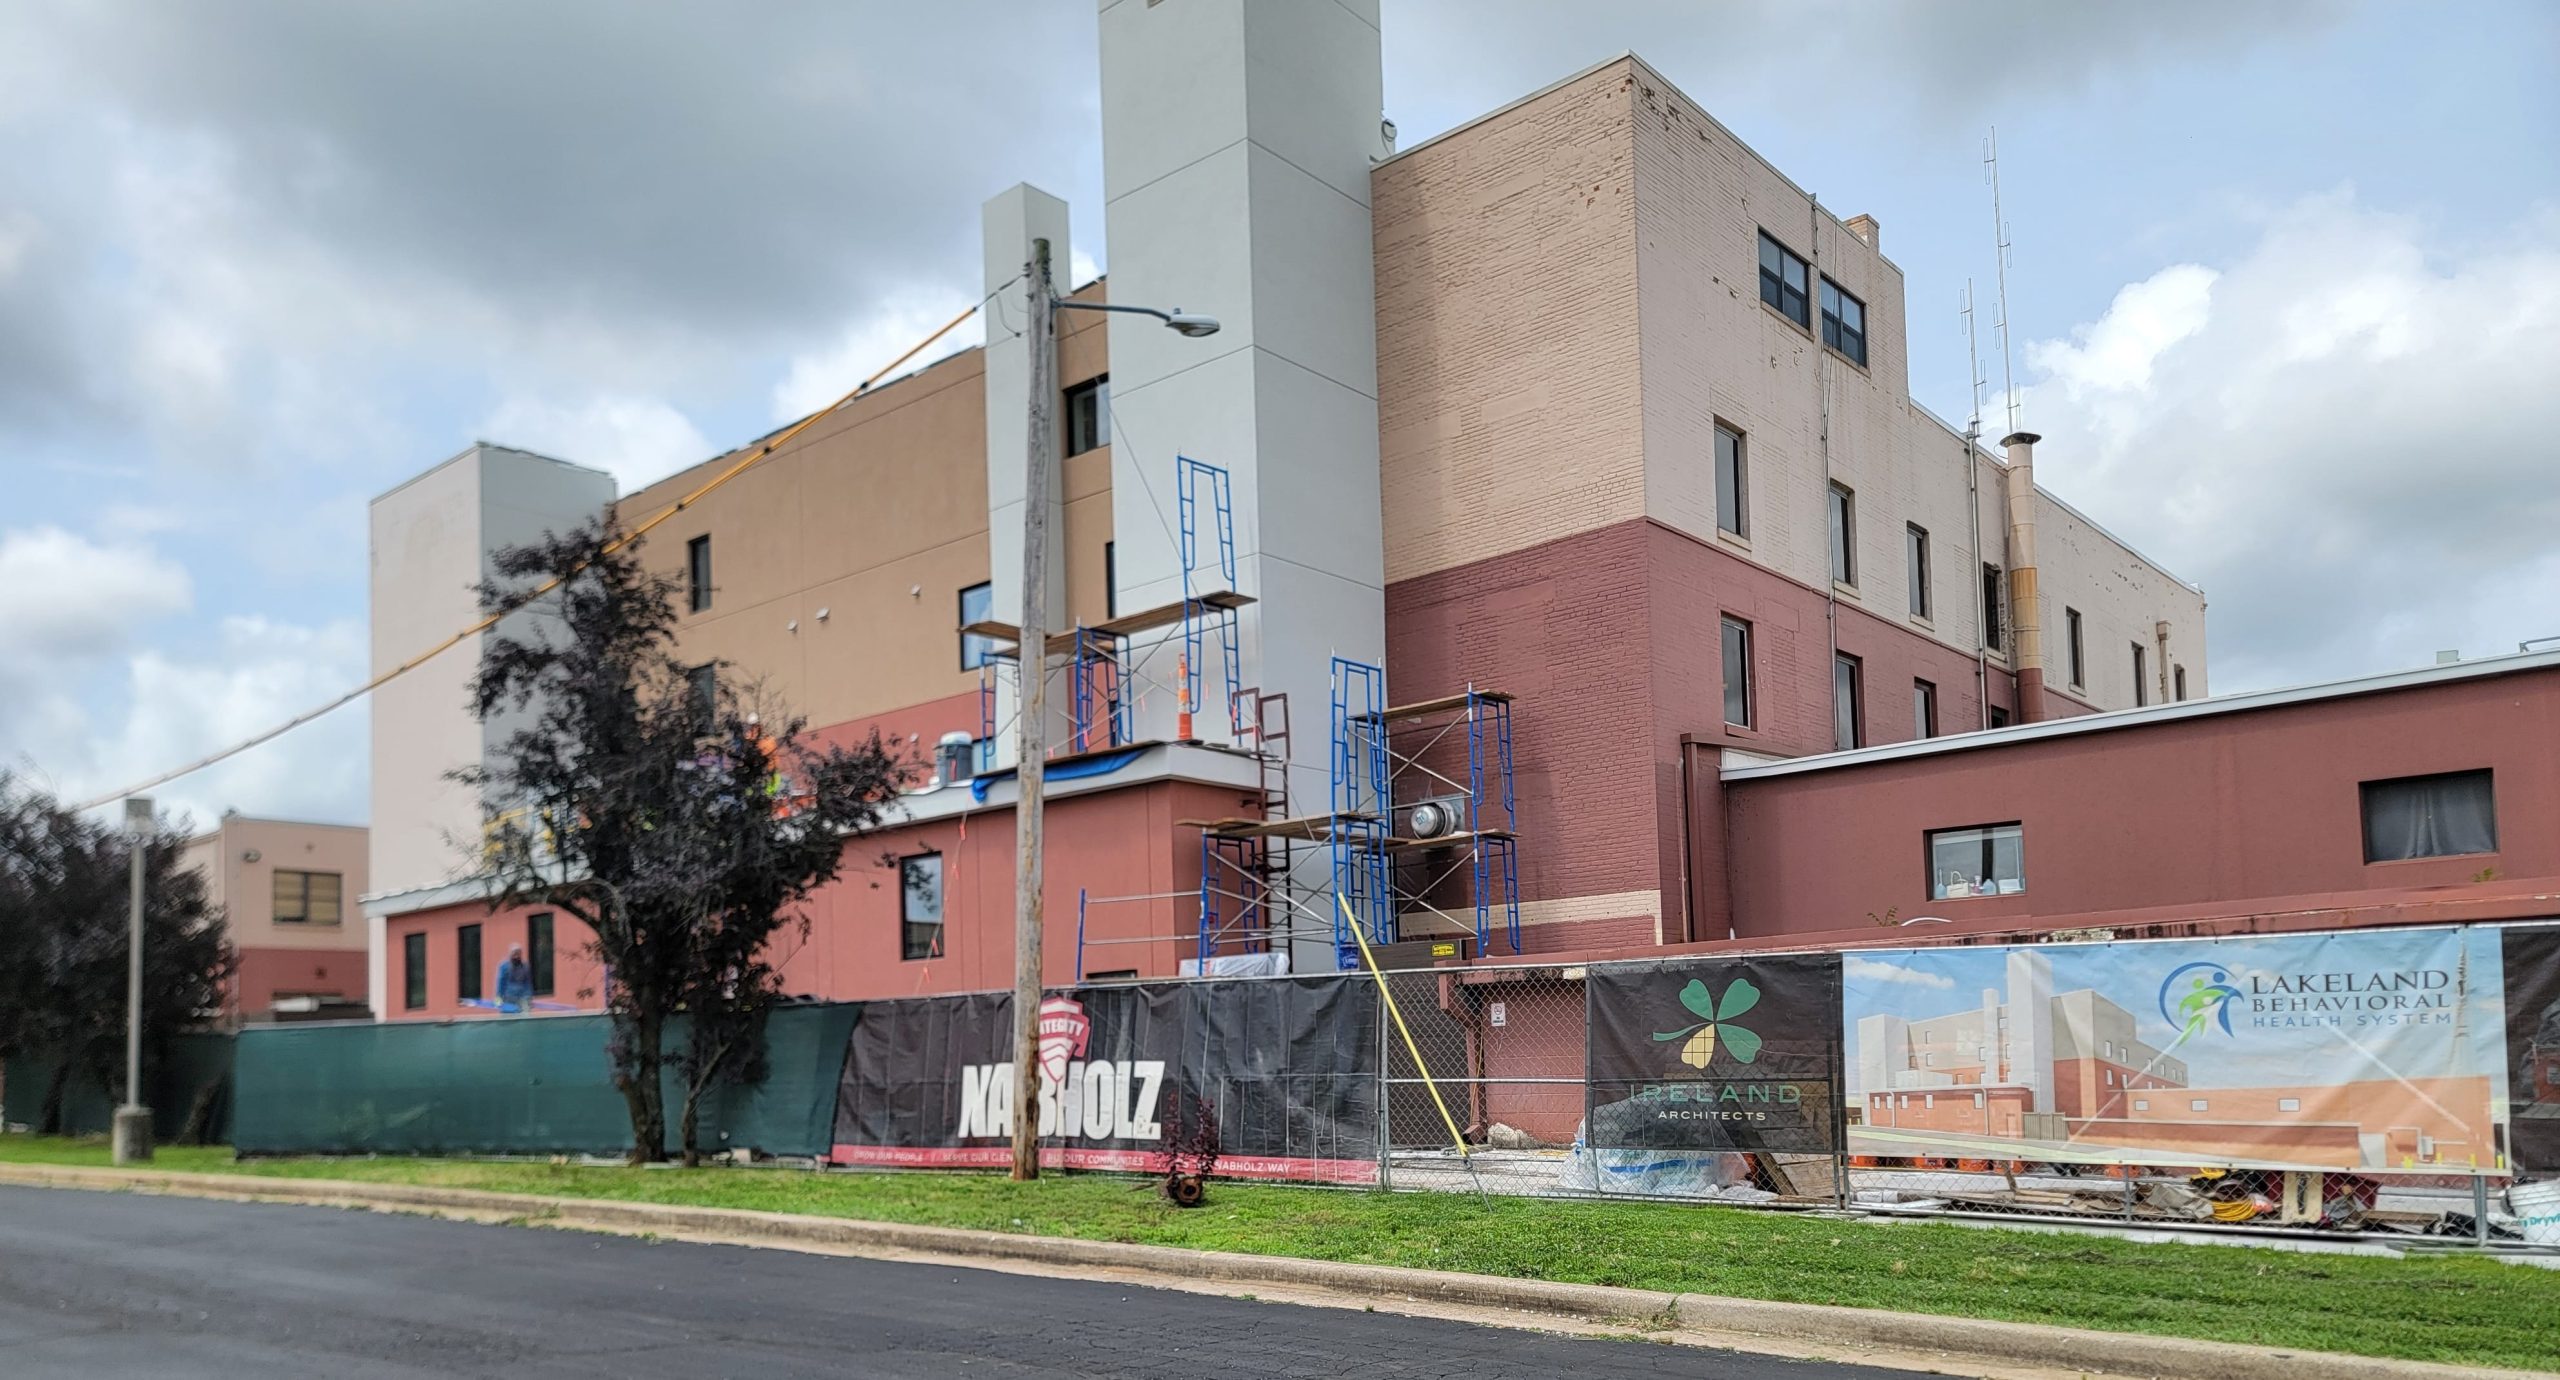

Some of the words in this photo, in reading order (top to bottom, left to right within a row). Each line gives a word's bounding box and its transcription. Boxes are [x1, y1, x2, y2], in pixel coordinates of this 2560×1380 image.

[2250, 970, 2449, 995] LAKELAND
[2252, 993, 2450, 1012] BEHAVIORAL
[2253, 1015, 2341, 1028] HEALTH
[2357, 1013, 2451, 1027] SYSTEM
[1630, 1083, 1801, 1104] IRELAND
[1658, 1110, 1767, 1121] ARCHITECTS
[1214, 1160, 1265, 1172] NABHOLZ
[1267, 1162, 1291, 1174] WAY
